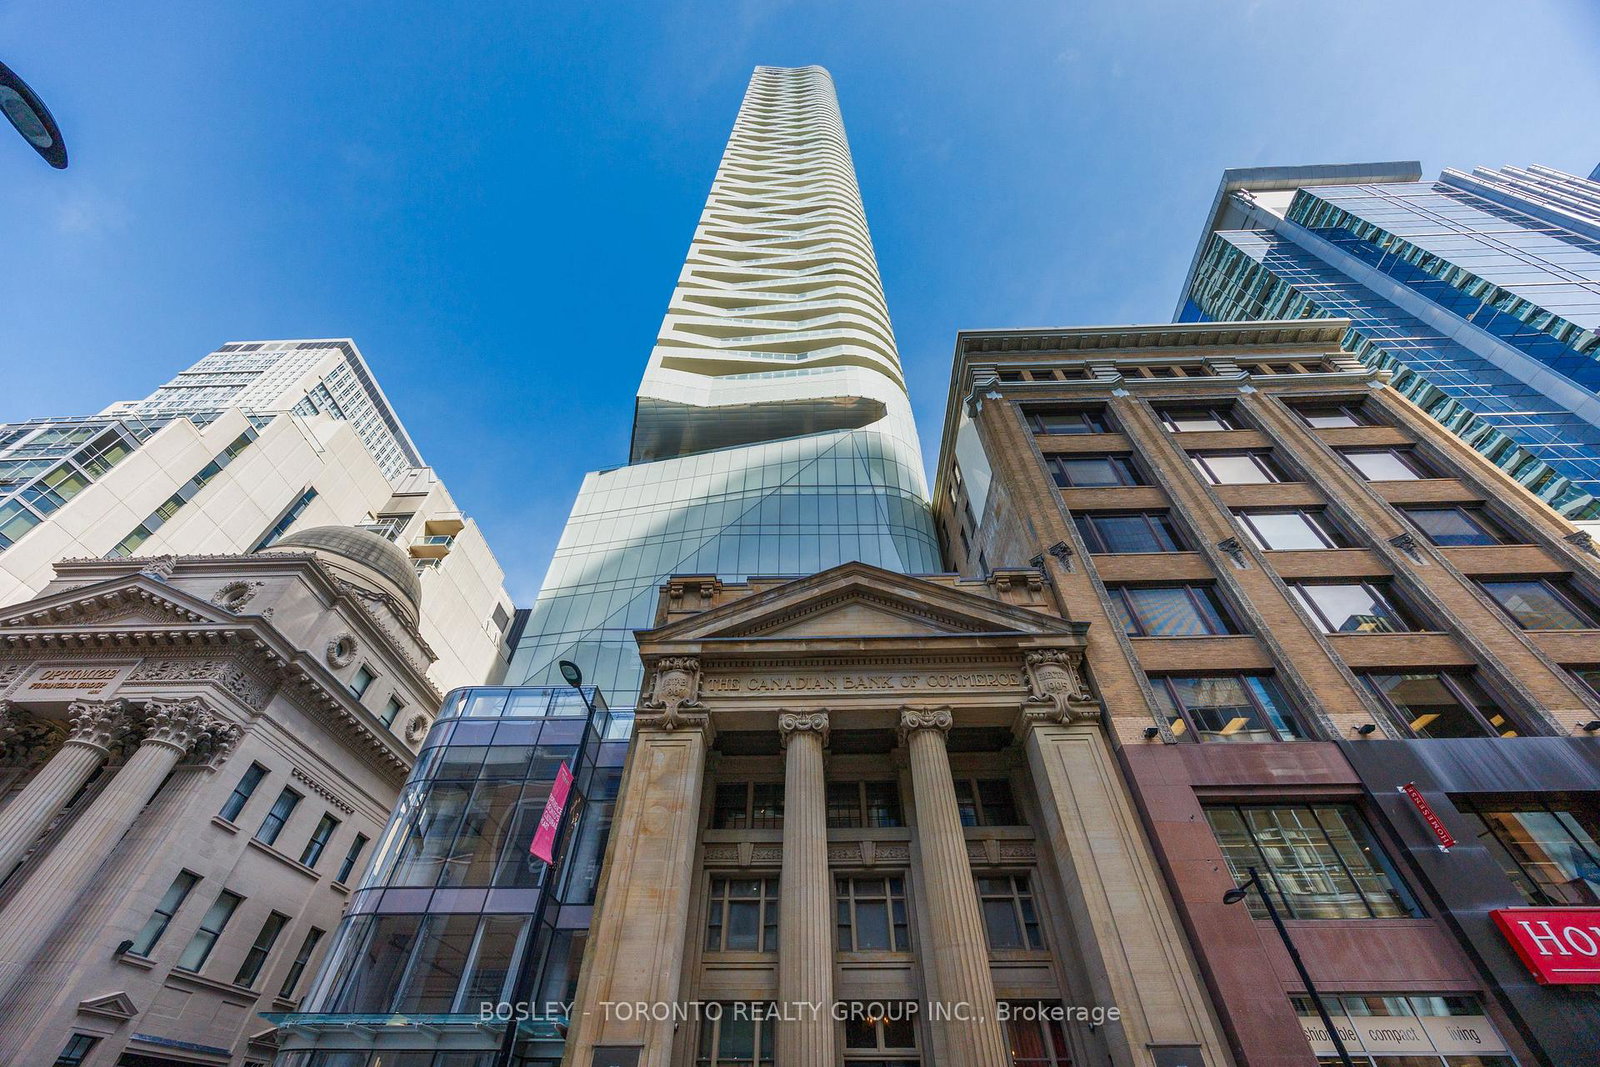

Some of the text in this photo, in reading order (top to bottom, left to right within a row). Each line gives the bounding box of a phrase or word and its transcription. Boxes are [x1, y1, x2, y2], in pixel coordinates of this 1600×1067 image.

[40, 669, 121, 681] OPTIMIZE
[708, 673, 1021, 692] THE CANADIAN BANK OF COMMERCE
[1406, 786, 1450, 844] HOMESENSE
[1517, 921, 1600, 957] HO
[1369, 1027, 1420, 1044] compact
[1446, 1026, 1482, 1044] living
